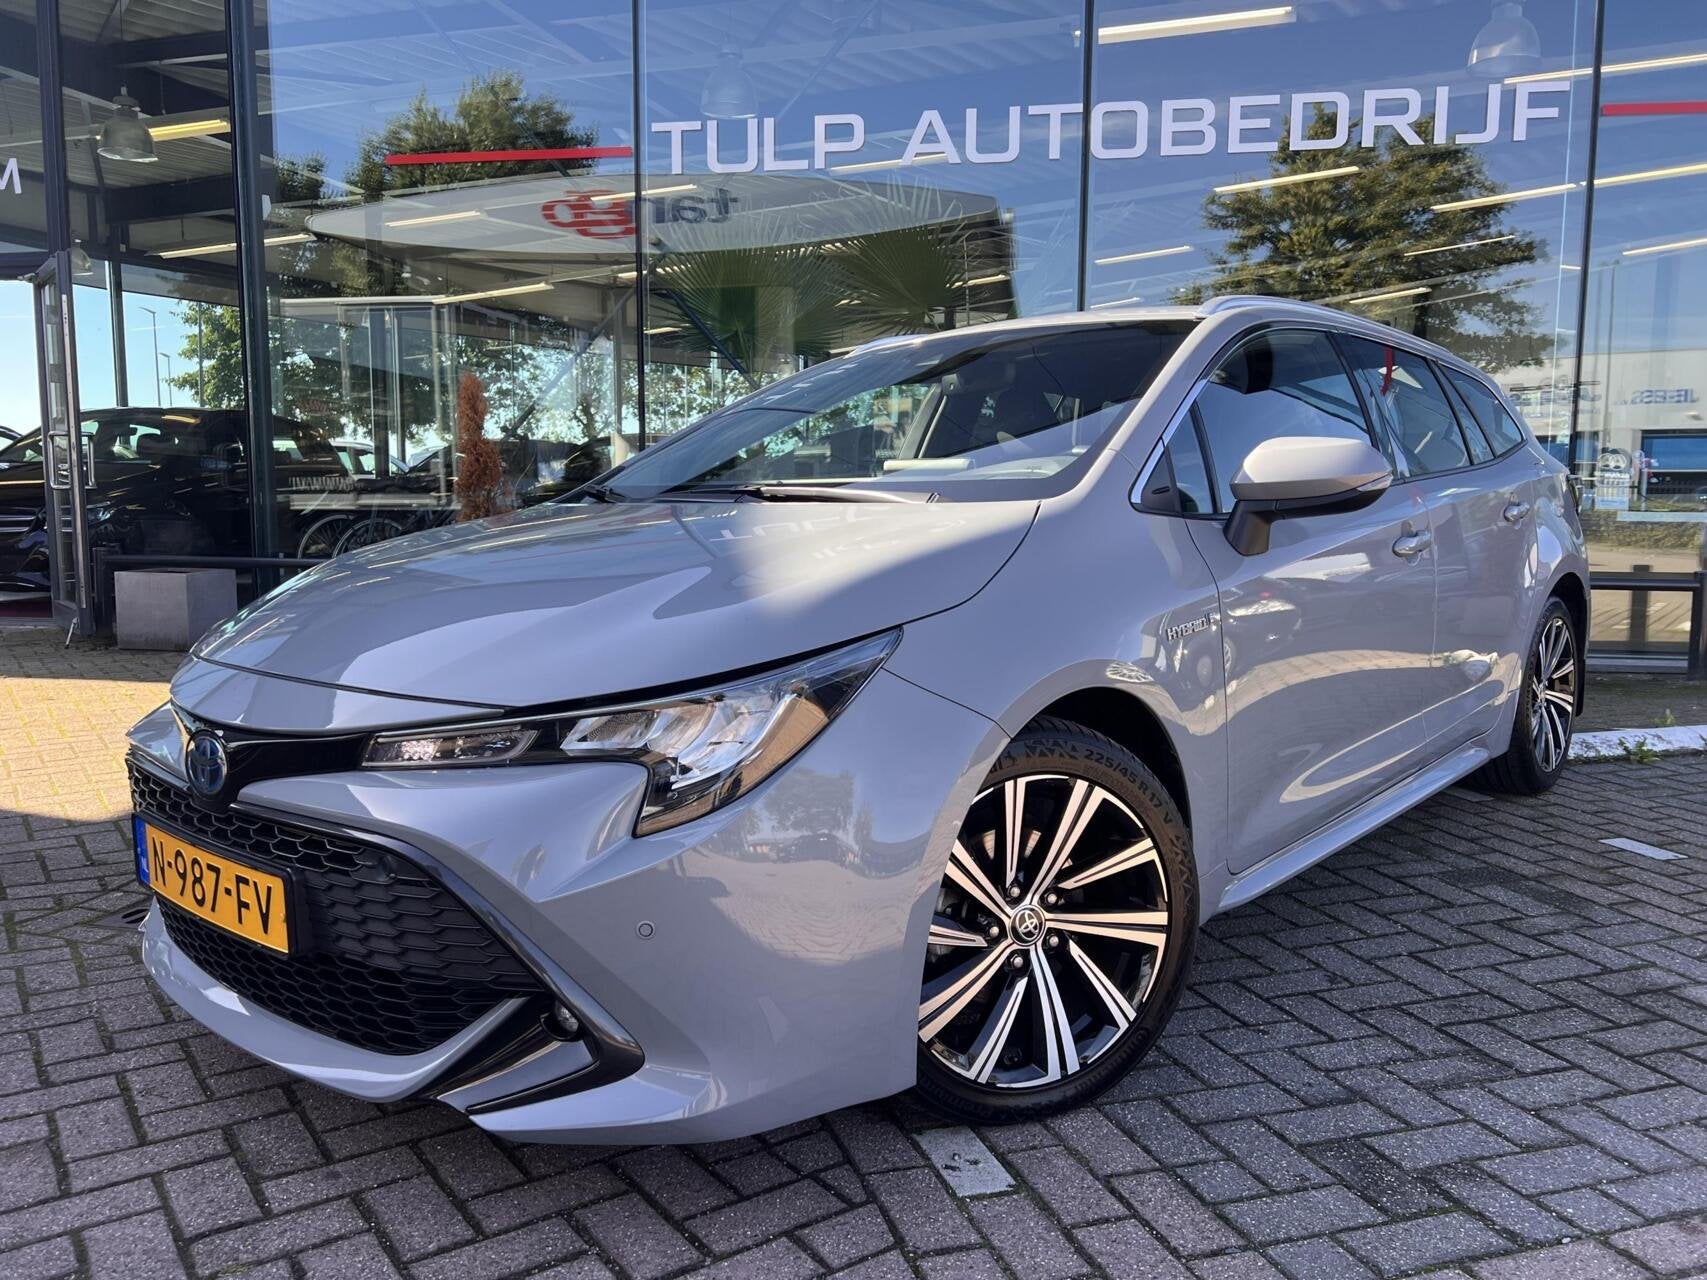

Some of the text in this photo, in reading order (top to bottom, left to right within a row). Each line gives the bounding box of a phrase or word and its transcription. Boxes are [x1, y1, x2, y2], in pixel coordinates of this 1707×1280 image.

[651, 80, 1571, 175] TULP AUTOBEDRIJF
[1166, 616, 1209, 641] HYBRID
[1084, 748, 1137, 784] 225/45
[151, 835, 272, 936] N-987-FV
